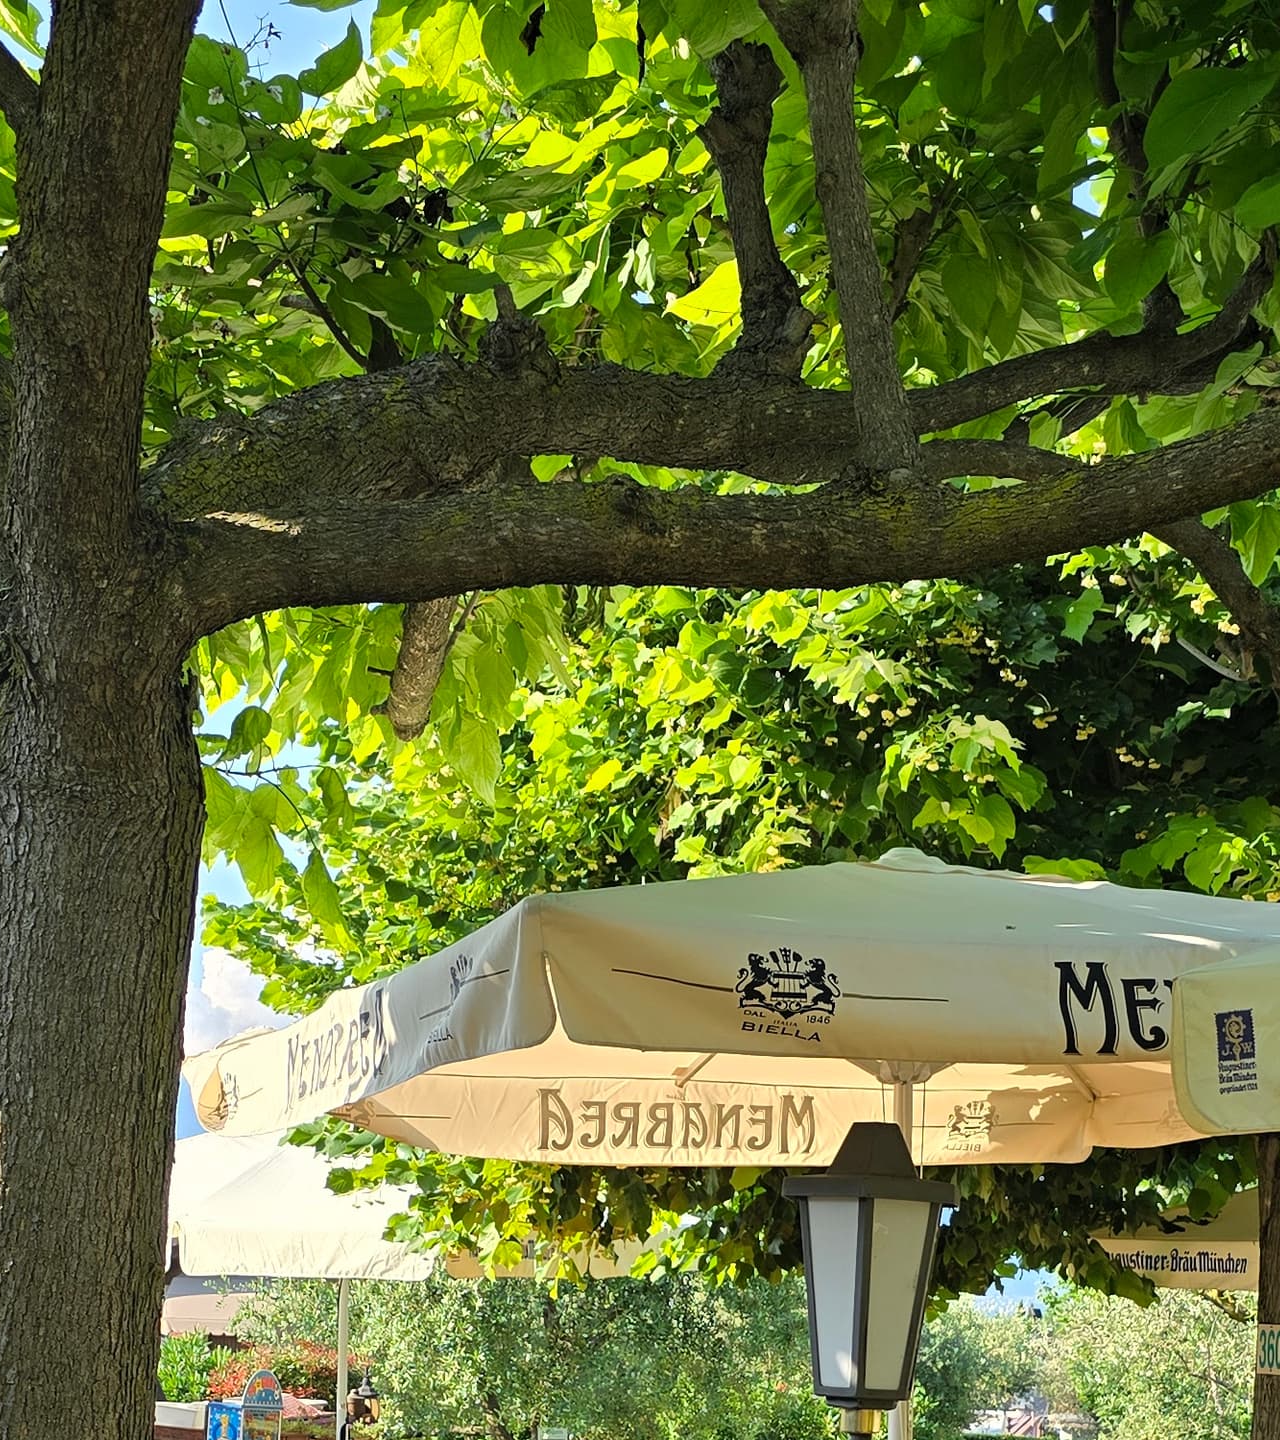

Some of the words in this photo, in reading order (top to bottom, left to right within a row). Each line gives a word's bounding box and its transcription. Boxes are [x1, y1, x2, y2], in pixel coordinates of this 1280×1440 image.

[743, 1009, 766, 1018] DAL
[1054, 962, 1172, 1056] ME
[806, 1015, 831, 1025] 1846
[741, 1021, 822, 1042] BIELLA
[1197, 1250, 1248, 1274] München
